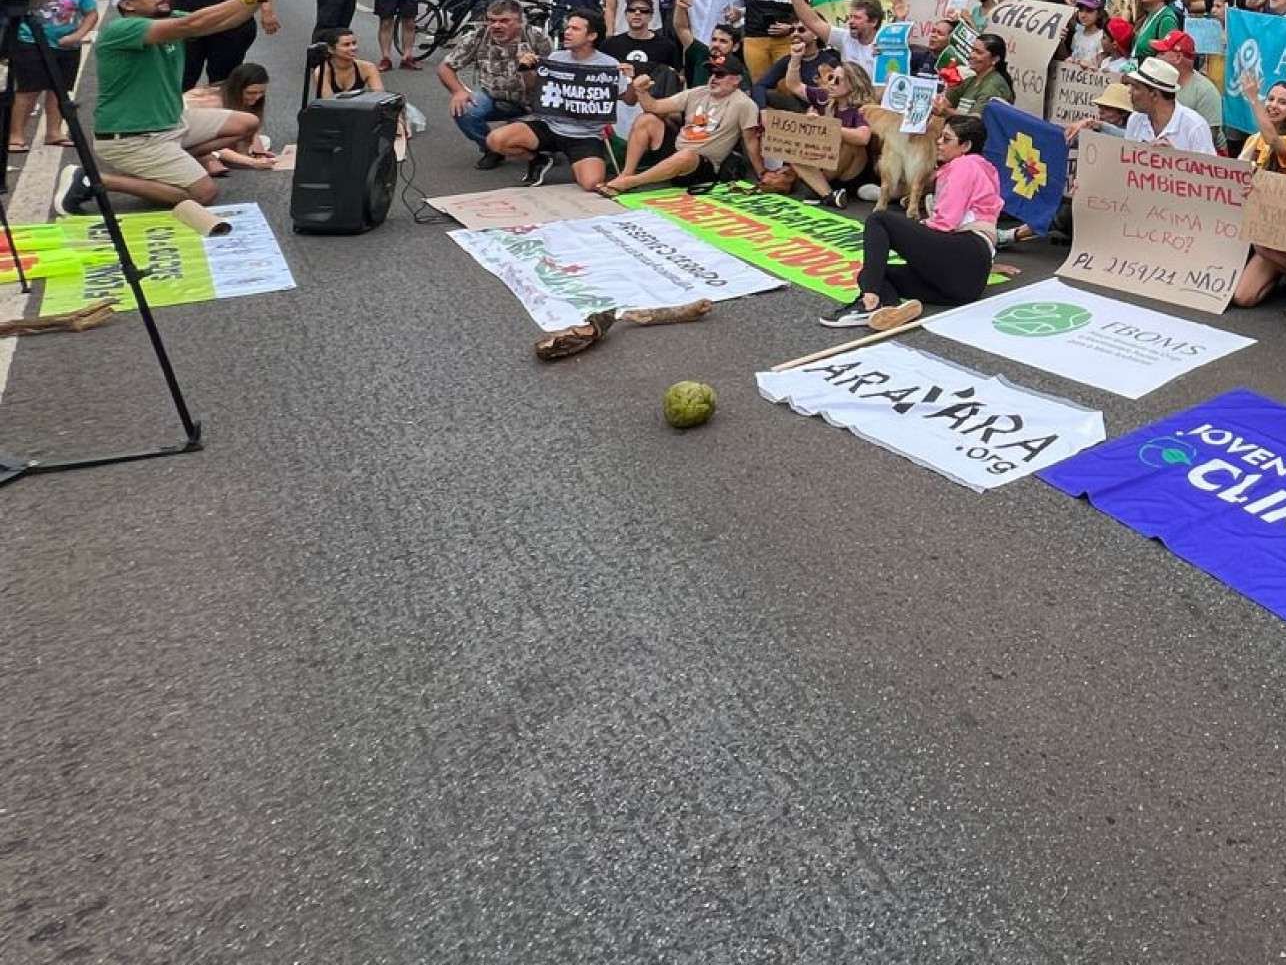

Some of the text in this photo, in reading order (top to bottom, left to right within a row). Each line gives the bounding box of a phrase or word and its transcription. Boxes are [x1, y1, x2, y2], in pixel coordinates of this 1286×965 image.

[991, 3, 1063, 40] CHEGA
[586, 86, 610, 101] SEM
[771, 115, 827, 136] HUGO MOTTA
[1085, 143, 1253, 185] O LICENCIAMENTO
[1086, 195, 1239, 238] ESTÁ ACIMA DO
[1122, 223, 1195, 254] LUCRO?
[1072, 252, 1238, 298] PL 2159/21 NÃO!
[1100, 321, 1207, 355] FBOMS
[956, 445, 1018, 475] .org
